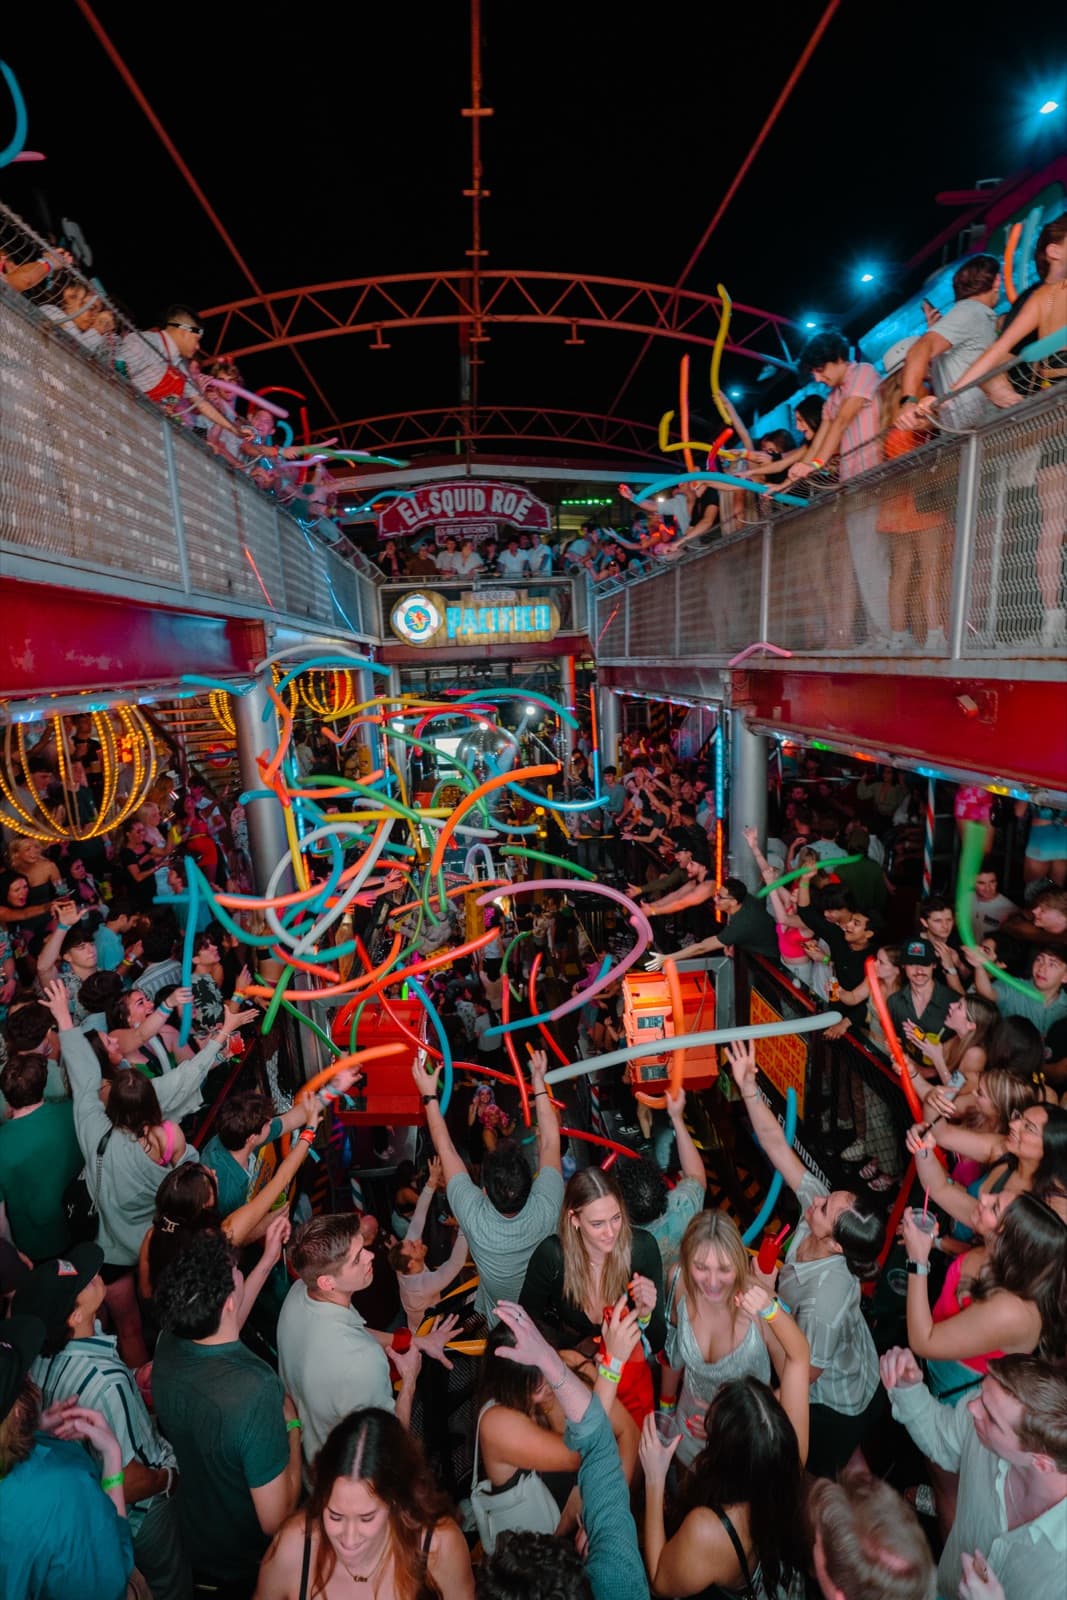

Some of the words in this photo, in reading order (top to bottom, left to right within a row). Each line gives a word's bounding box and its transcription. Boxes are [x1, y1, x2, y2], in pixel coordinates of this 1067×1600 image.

[396, 495, 430, 526] EL
[429, 488, 486, 518] SQUID
[490, 489, 532, 522] ROE
[446, 604, 550, 639] PACIFICO
